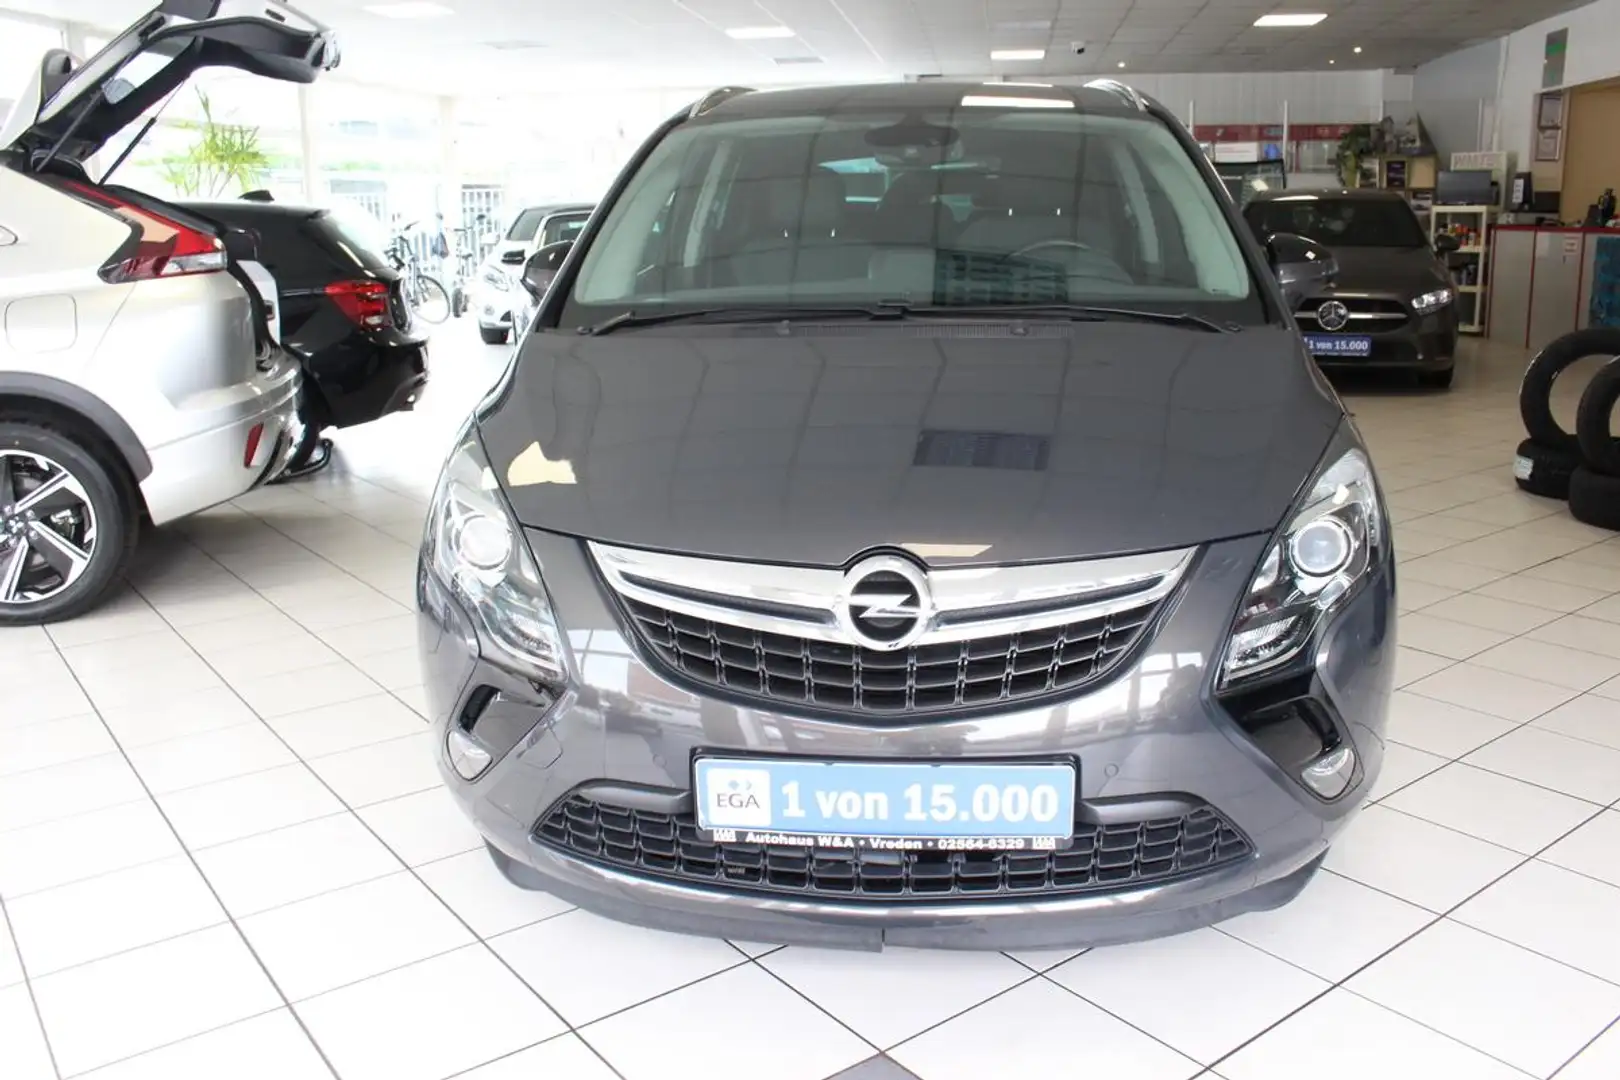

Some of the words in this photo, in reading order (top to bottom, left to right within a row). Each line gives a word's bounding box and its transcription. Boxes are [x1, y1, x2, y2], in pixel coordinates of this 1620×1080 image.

[716, 792, 760, 809] EGA
[781, 781, 805, 818] 1
[816, 790, 888, 821] von
[904, 783, 1059, 822] 15.000
[745, 831, 814, 846] Autohaus
[817, 835, 855, 848] W&A
[870, 838, 922, 849] Vreden
